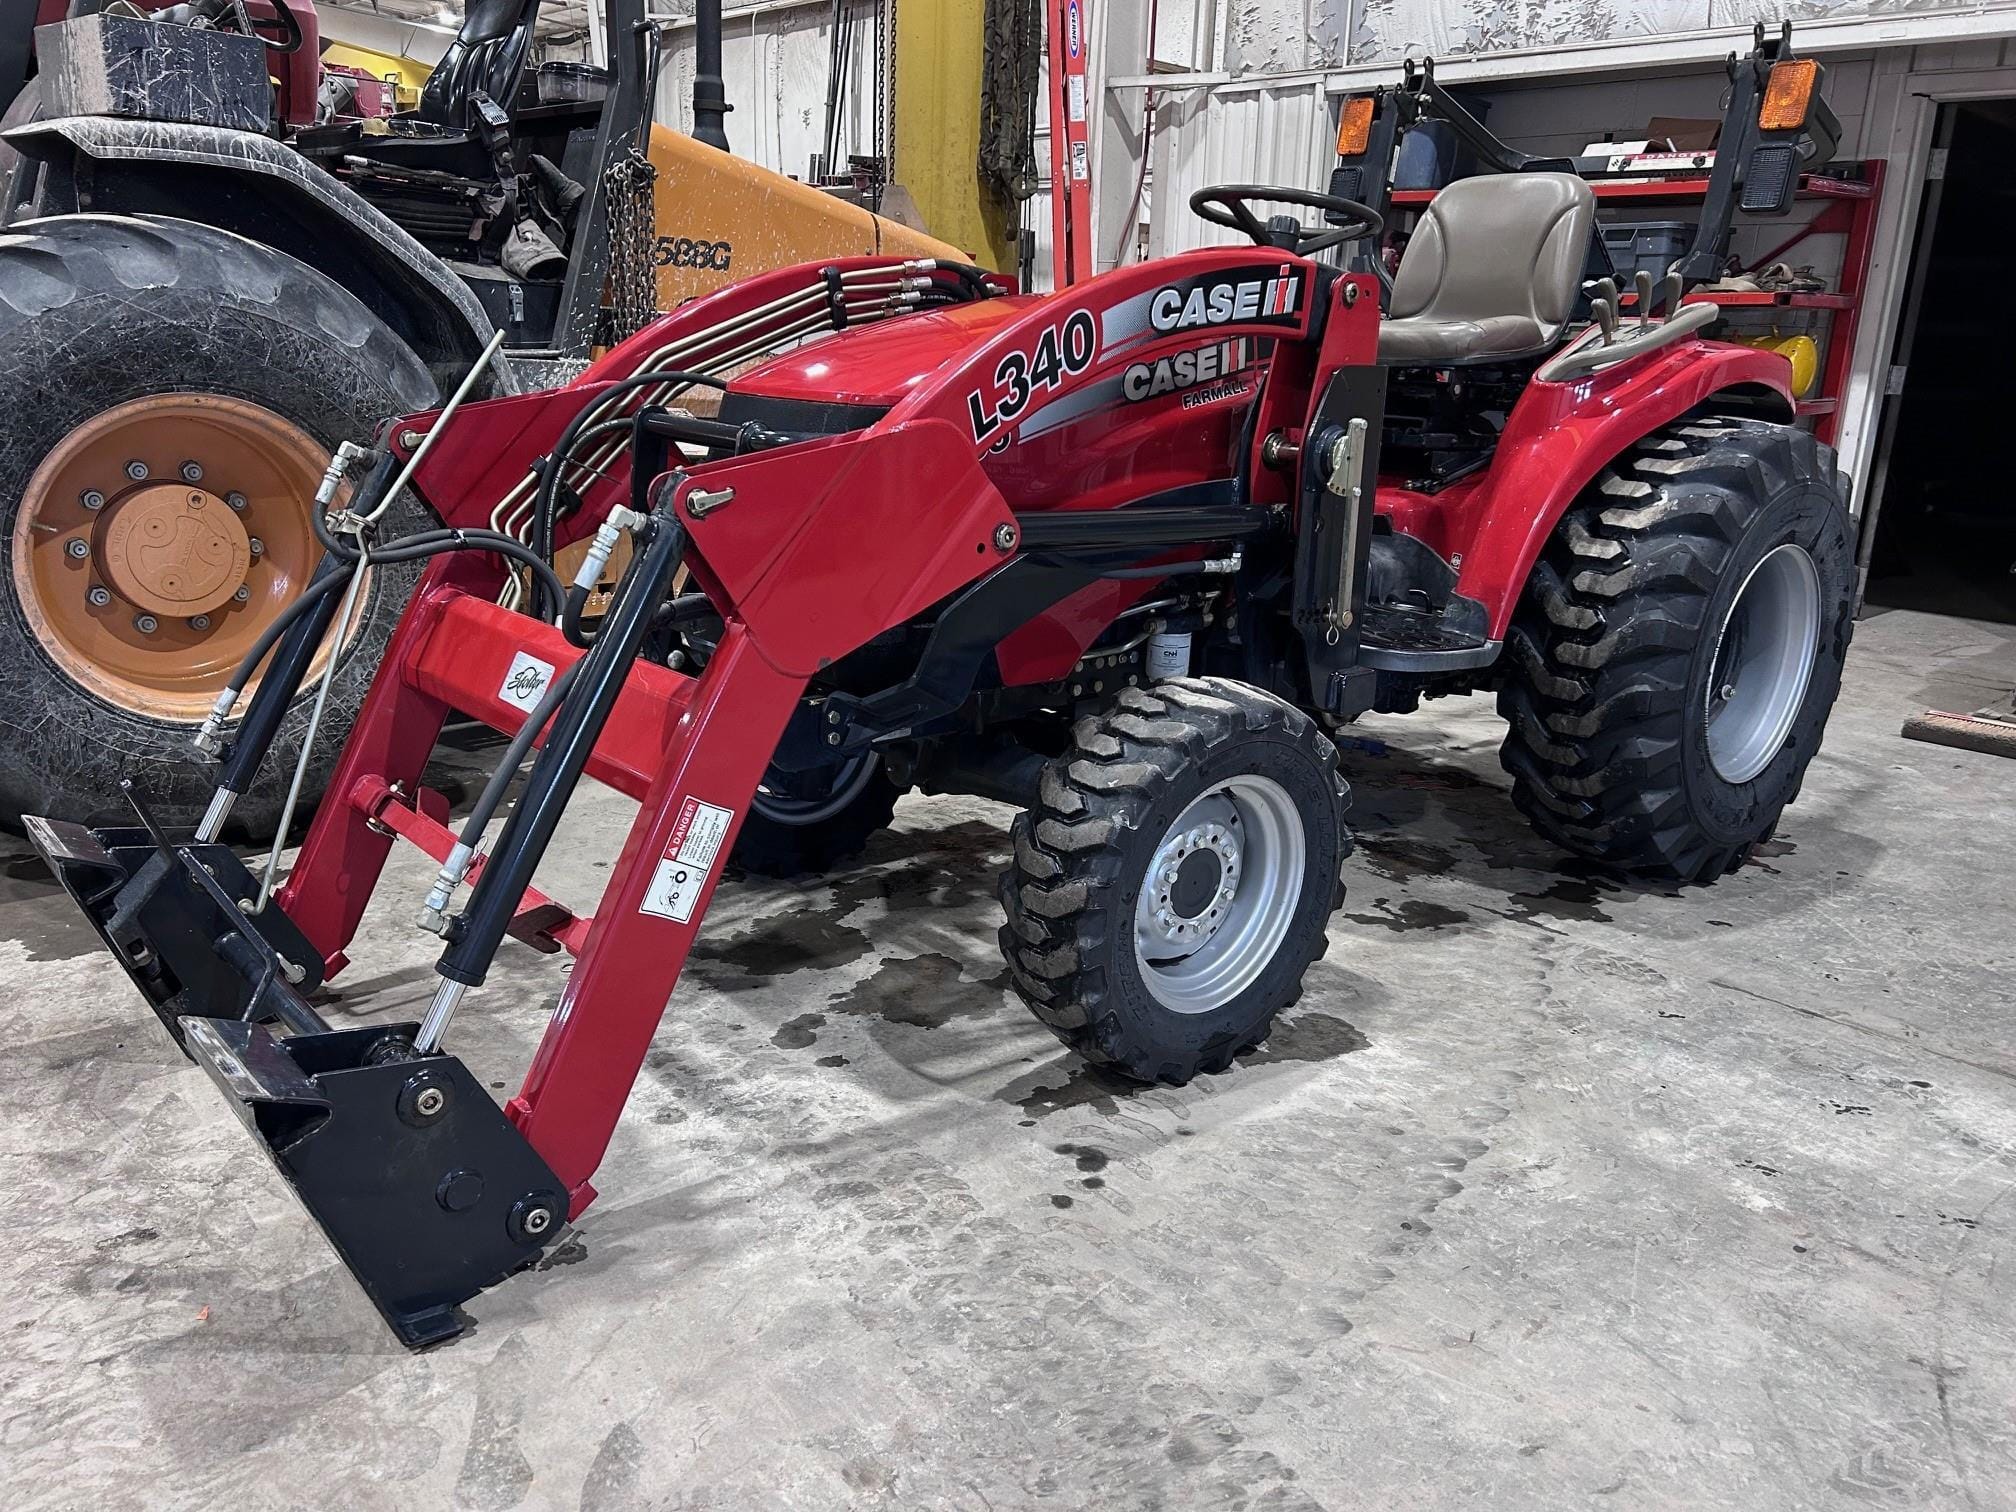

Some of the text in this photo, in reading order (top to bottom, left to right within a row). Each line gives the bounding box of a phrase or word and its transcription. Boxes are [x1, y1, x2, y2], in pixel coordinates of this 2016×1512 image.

[652, 236, 732, 271] 588G
[966, 307, 1096, 445] L340
[1182, 381, 1249, 410] FARMALL
[673, 803, 695, 844] DANGER
